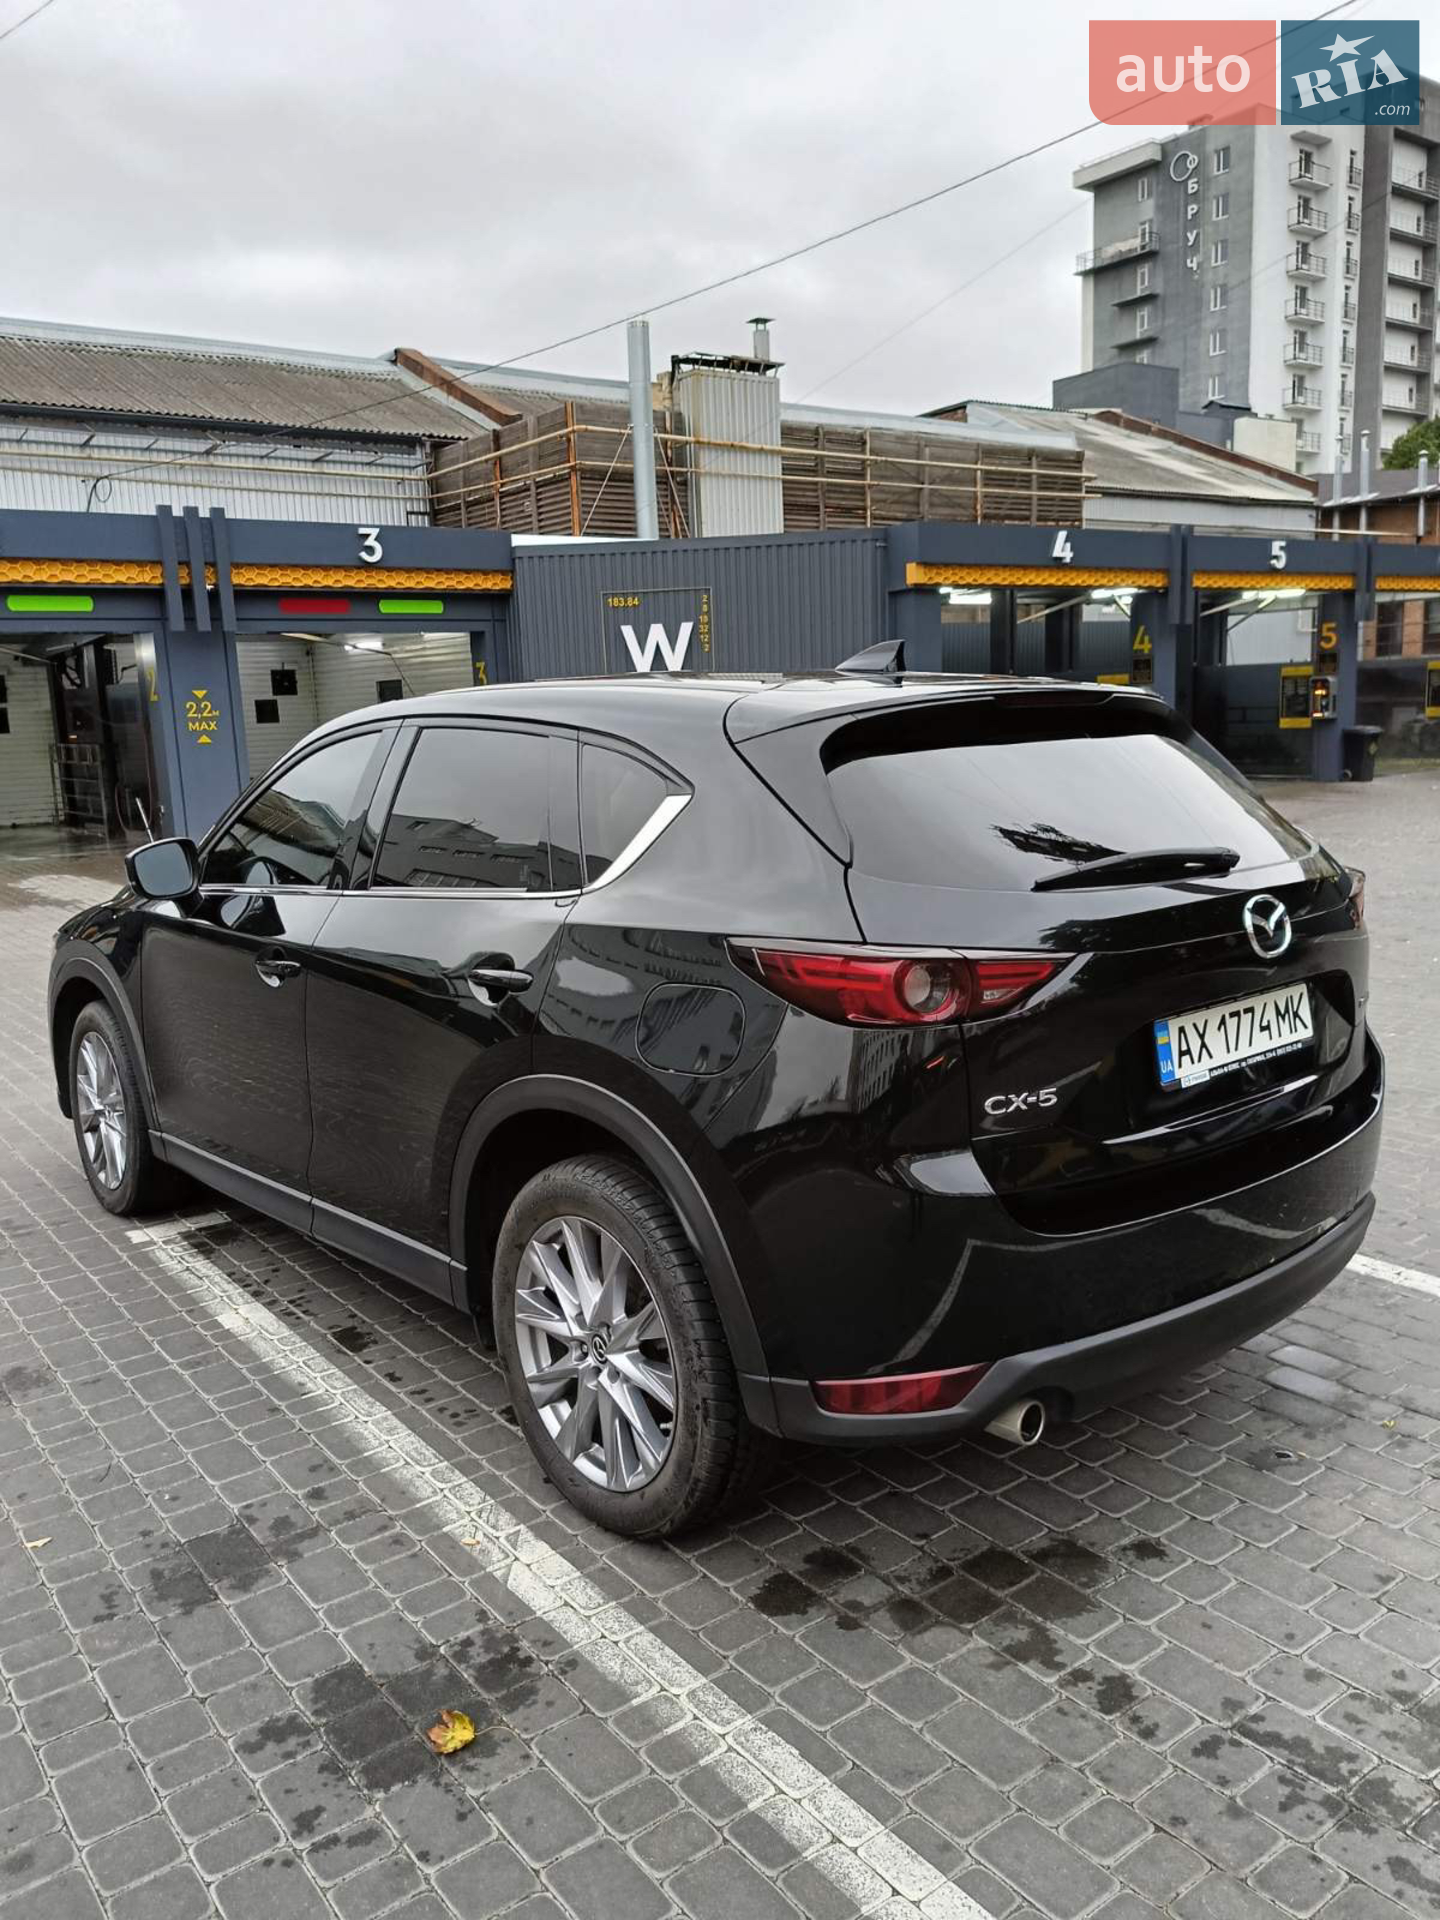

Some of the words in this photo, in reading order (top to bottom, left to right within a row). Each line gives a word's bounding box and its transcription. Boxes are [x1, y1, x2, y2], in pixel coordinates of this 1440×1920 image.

[358, 527, 383, 563] 3
[1052, 530, 1074, 563] 4
[1270, 540, 1287, 569] 5
[607, 596, 640, 608] 183.84
[620, 621, 694, 673] W
[1132, 625, 1152, 653] 4
[1320, 622, 1337, 649] 5
[189, 721, 218, 731] MAX
[1177, 1018, 1213, 1069] AX
[1217, 1001, 1272, 1054] 1774
[1273, 992, 1308, 1038] MK
[1160, 1060, 1174, 1073] UA
[984, 1087, 1058, 1115] CX-5
